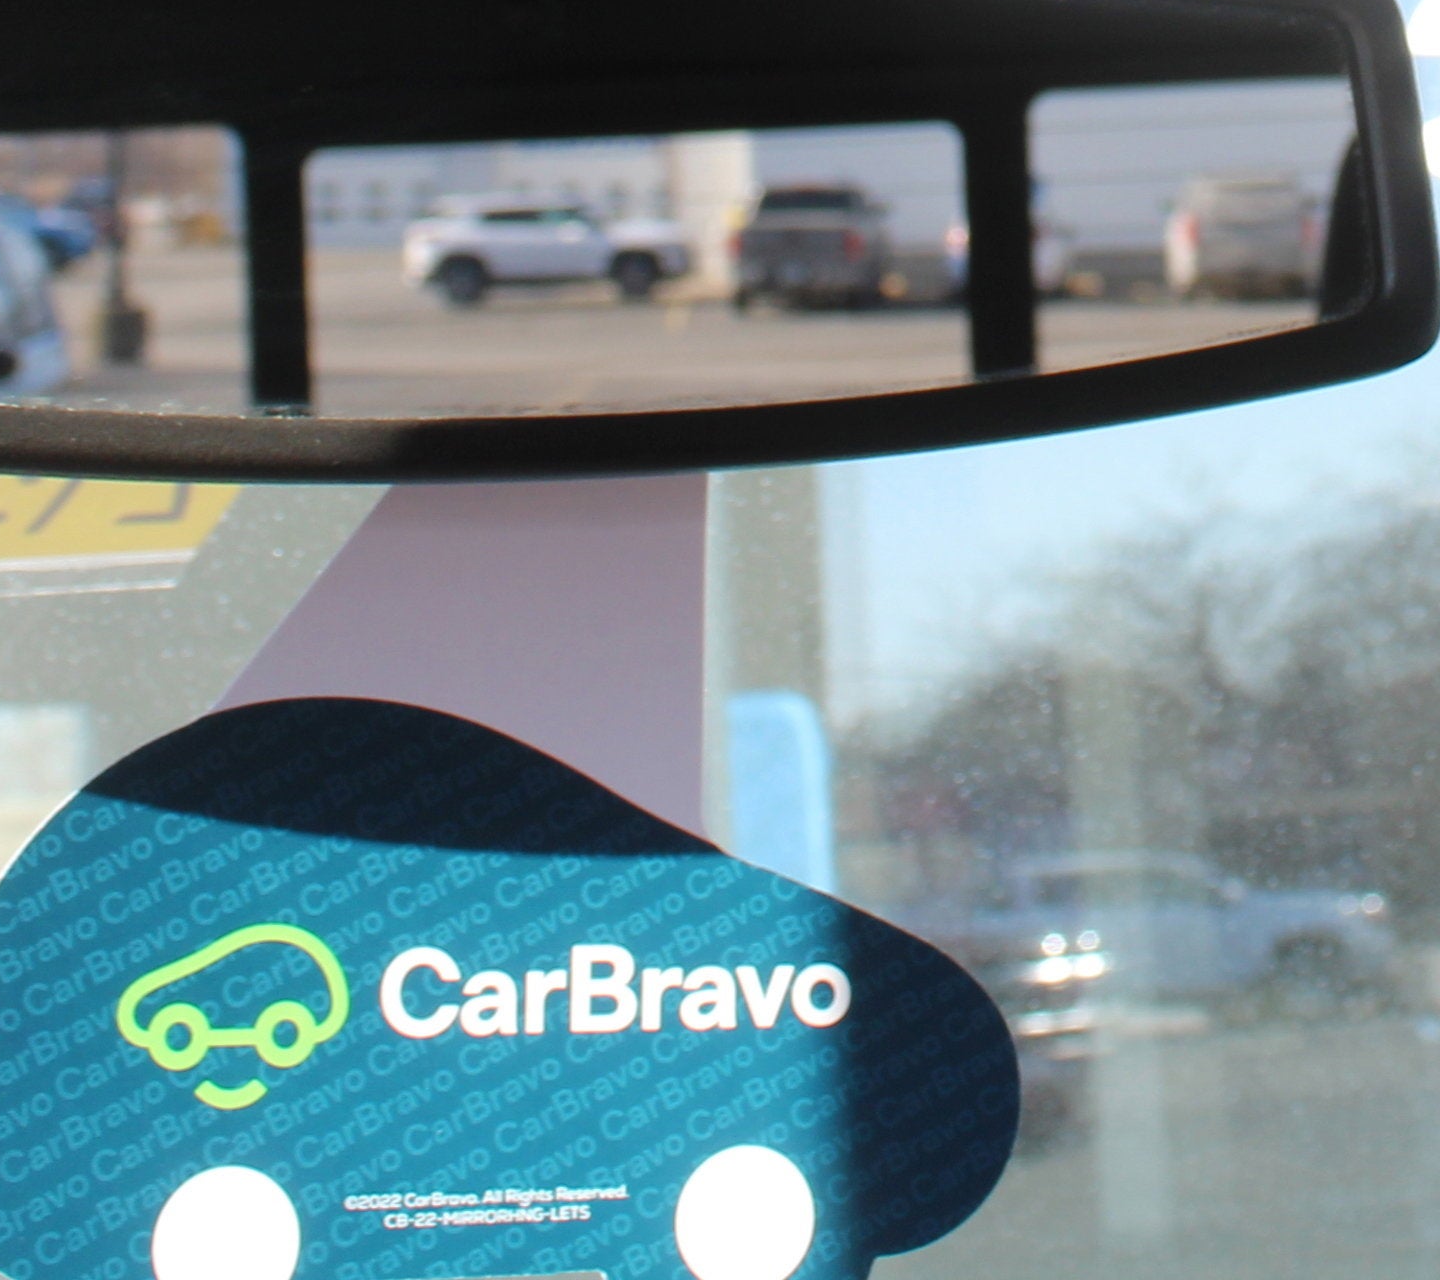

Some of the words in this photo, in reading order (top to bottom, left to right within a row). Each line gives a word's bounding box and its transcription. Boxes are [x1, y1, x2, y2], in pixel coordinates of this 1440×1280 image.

[380, 942, 852, 1040] CarBravo
[482, 1189, 503, 1204] All
[504, 1188, 554, 1208] Rights
[556, 1184, 630, 1202] Reserved.
